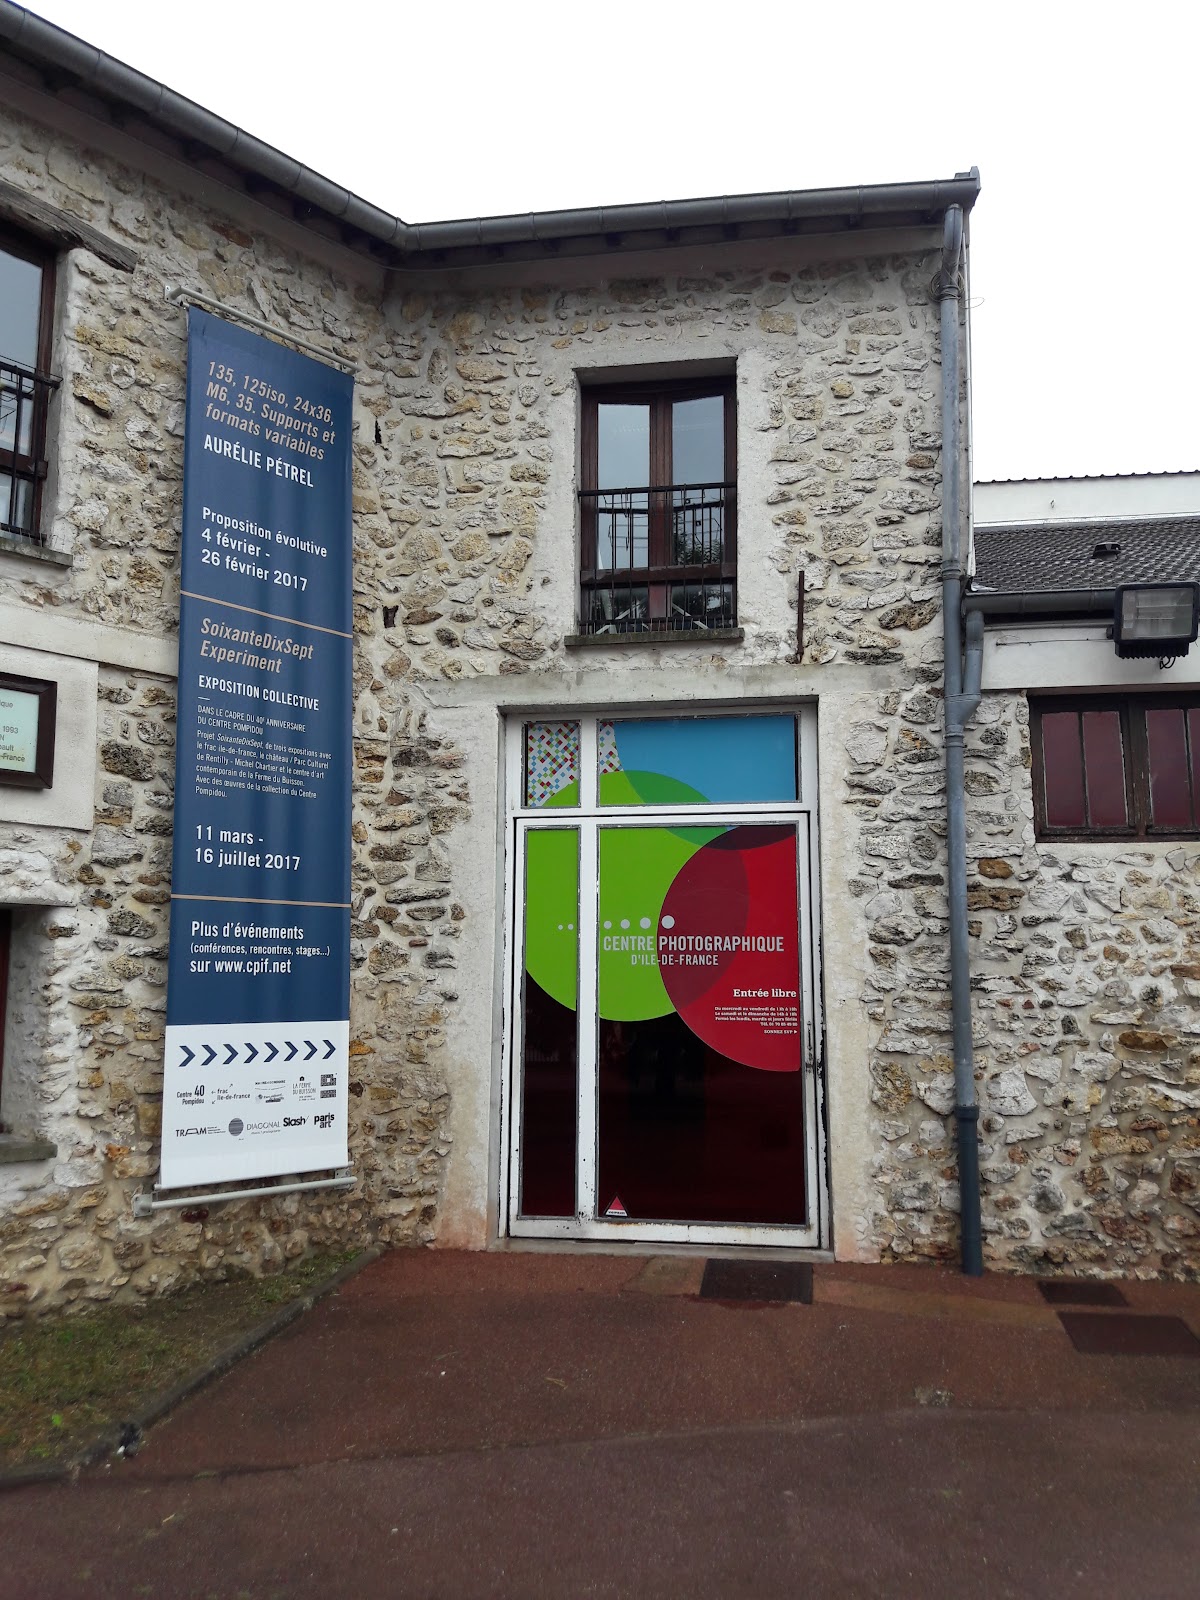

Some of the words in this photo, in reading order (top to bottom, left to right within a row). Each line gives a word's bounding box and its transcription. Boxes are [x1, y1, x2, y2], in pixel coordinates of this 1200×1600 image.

[209, 361, 236, 386] 135,
[244, 376, 288, 407] 125iso,
[294, 397, 334, 426] 24x36,
[207, 382, 230, 405] M6,
[236, 393, 255, 413] 35.
[261, 404, 318, 438] Supports
[323, 430, 335, 445] et
[206, 403, 260, 436] formats
[265, 428, 324, 460] variables
[204, 434, 261, 468] AURÉLIE
[267, 456, 313, 487] PÉTREL
[202, 528, 211, 542] 4
[217, 531, 261, 557] février
[203, 507, 271, 540] Proposition
[276, 530, 327, 557] évolutive
[201, 549, 220, 566] 26
[225, 557, 269, 581] février
[274, 571, 307, 592] 2017
[201, 618, 313, 660] SoixanteDixSept
[200, 640, 282, 673] Experiment
[199, 675, 259, 698] EXPOSITION
[263, 689, 319, 710] COLLECTIVE
[198, 705, 214, 715] DANS
[216, 708, 222, 716] LE
[225, 709, 244, 720] CADRE
[247, 714, 254, 722] DU
[266, 719, 306, 732] ANNIVERSAIRE
[198, 716, 206, 724] DU
[208, 718, 231, 729] CENTRE
[233, 722, 263, 735] POMPIDOU
[197, 730, 215, 741] Projet
[274, 744, 286, 752] trois
[288, 746, 317, 757] expositions
[204, 743, 216, 751] frac
[266, 752, 288, 763] château
[307, 760, 328, 769] Culturel
[206, 754, 228, 765] Rentilly
[235, 759, 253, 768] Michel
[256, 761, 278, 772] Chartier
[196, 764, 237, 777] contemporain
[255, 772, 271, 782] Ferme
[282, 776, 305, 786] Buisson.
[196, 775, 210, 783] Avec
[212, 777, 222, 785] des
[262, 784, 289, 794] collection
[298, 789, 316, 798] Centre
[196, 786, 227, 798] Pompidou.
[196, 825, 212, 840] 11
[220, 830, 253, 844] mars
[196, 848, 213, 863] 16
[218, 849, 260, 867] juillet
[265, 854, 300, 870] 2017
[191, 921, 218, 937] Plus
[190, 943, 247, 955] (conférences,
[250, 945, 293, 955] rencontres,
[603, 936, 654, 950] CENTRE
[659, 936, 784, 952] PHOTOGRAPHIQUE
[190, 960, 210, 973] sur
[215, 958, 291, 975] www.cpif.net
[632, 954, 718, 965] D'ILE-DE-FRANCE
[733, 989, 769, 997] Entrée
[772, 989, 796, 997] libre
[195, 1085, 204, 1096] 40
[247, 1121, 280, 1130] DIAGONAL
[314, 1112, 334, 1125] paris
